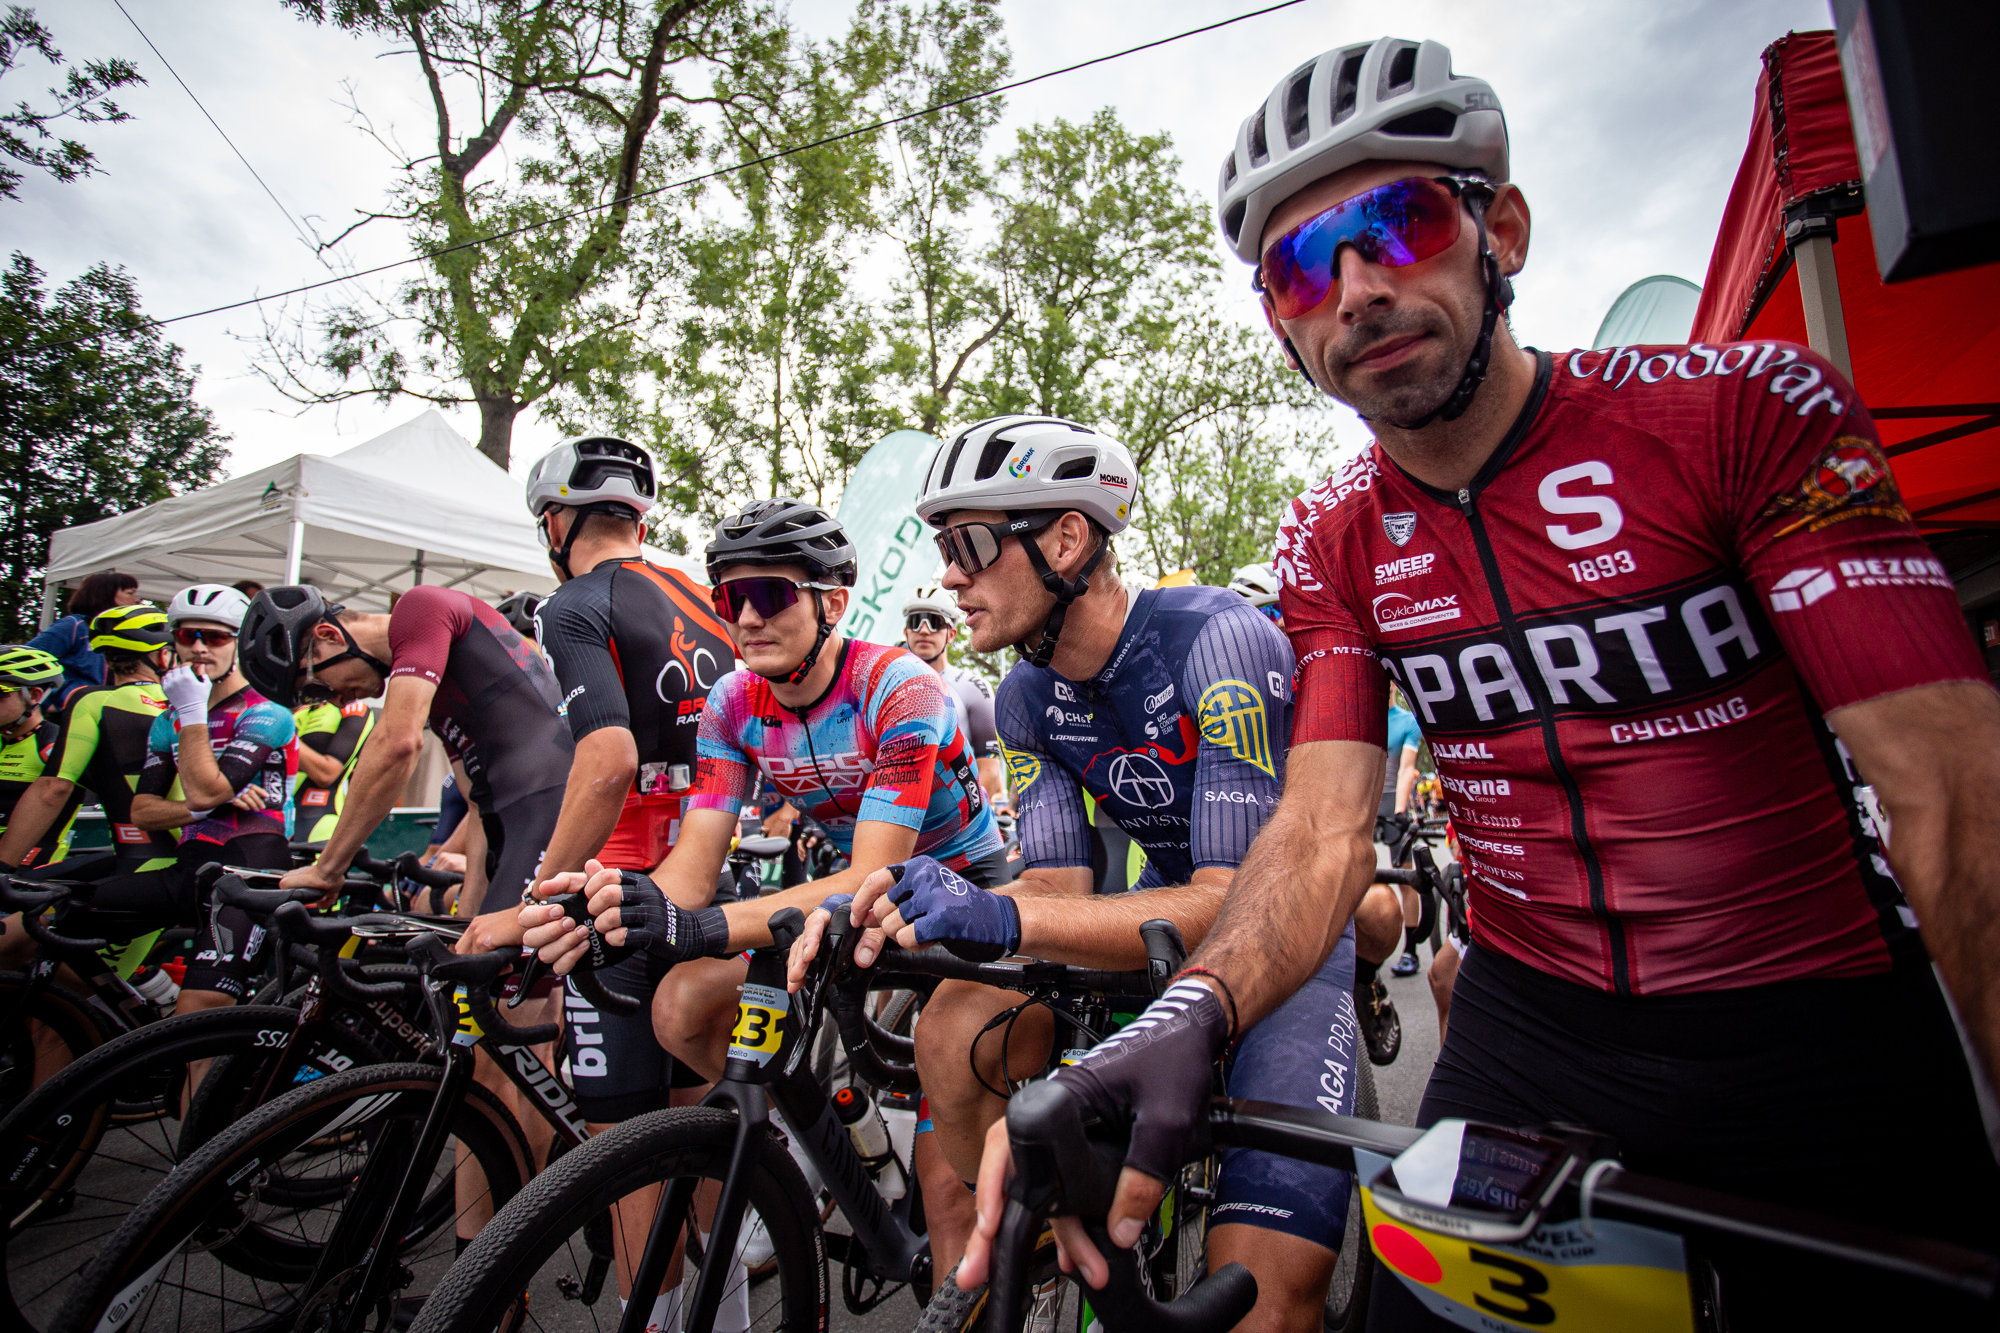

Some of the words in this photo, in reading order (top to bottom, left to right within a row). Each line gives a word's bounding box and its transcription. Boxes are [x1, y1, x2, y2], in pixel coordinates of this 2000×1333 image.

[1016, 447, 1035, 471] BREMA
[1100, 473, 1128, 486] MONZAS
[1322, 461, 1382, 511] SPOR
[1537, 459, 1624, 550] S
[1374, 552, 1436, 580] SWEEP
[1375, 571, 1406, 586] ULTIMATE
[1407, 567, 1432, 579] SPORT
[1568, 549, 1638, 583] 1893
[1382, 594, 1459, 620] CykloMAX
[676, 714, 702, 726] RAC
[677, 700, 706, 717] BR
[1157, 712, 1167, 722] UCI
[1610, 697, 1749, 744] CYCLING
[1050, 734, 1099, 742] LAPIERRE
[1432, 742, 1494, 759] ALKAL
[1204, 790, 1259, 806] SAGA
[1439, 774, 1511, 801] saxana
[1018, 799, 1045, 815] AHA
[1475, 796, 1497, 805] Group
[1457, 832, 1525, 856] PROGRESS
[1328, 990, 1356, 1059] PRAHA
[728, 1048, 748, 1058] bolito
[502, 1044, 591, 1143] RIDL
[1315, 1056, 1349, 1115] AGA
[1211, 1202, 1294, 1218] LAPIERRE
[1468, 1246, 1555, 1325] 3
